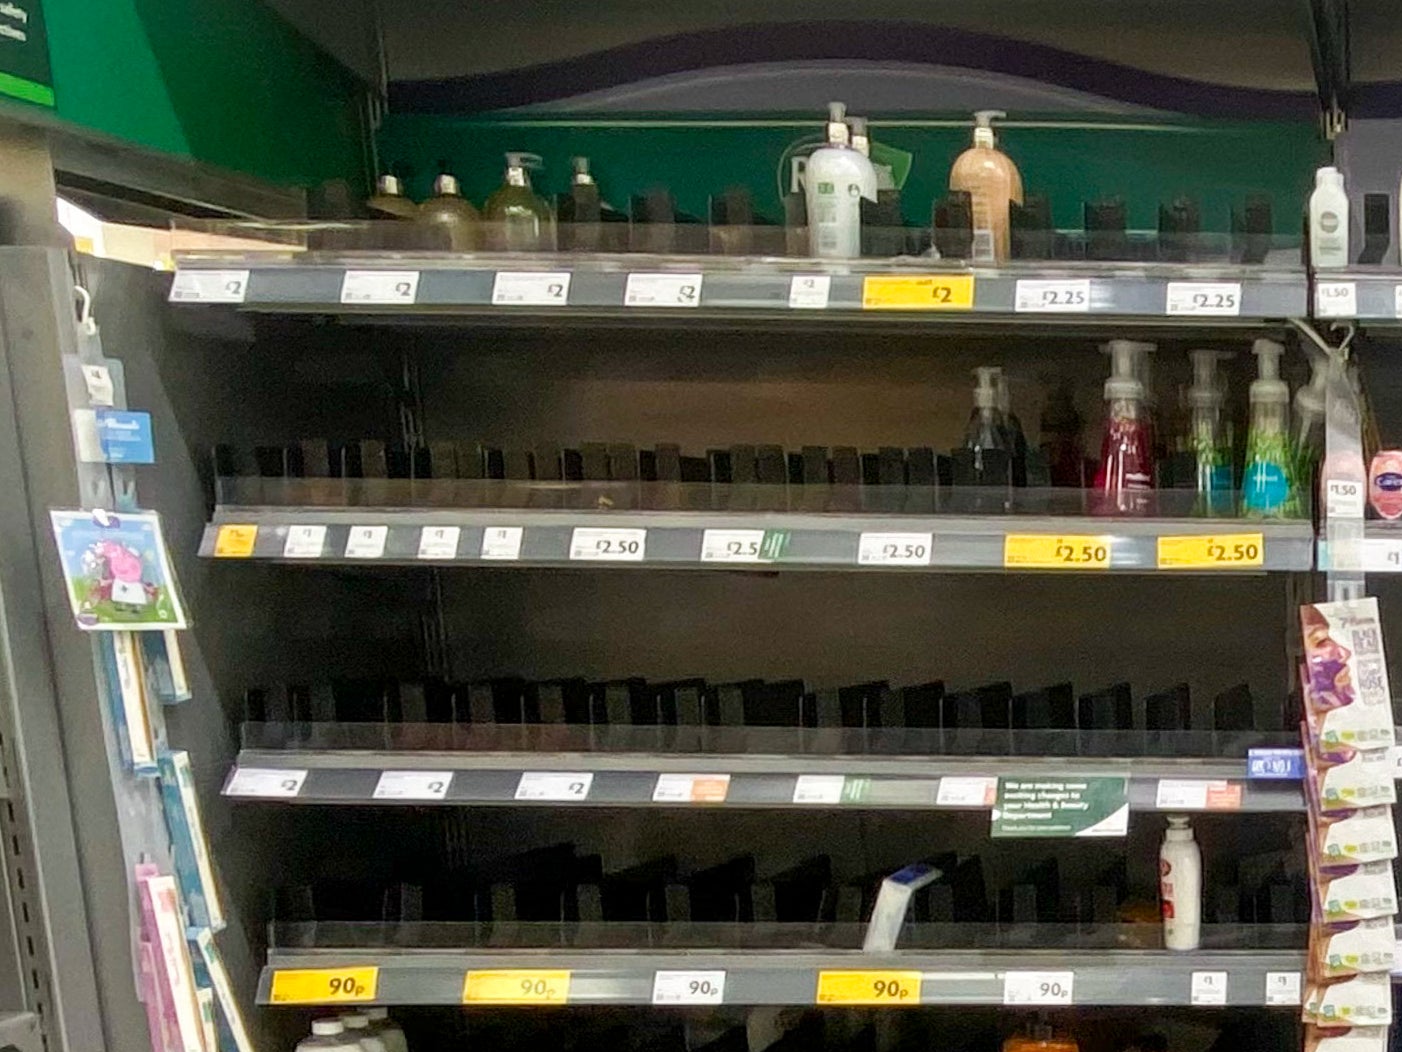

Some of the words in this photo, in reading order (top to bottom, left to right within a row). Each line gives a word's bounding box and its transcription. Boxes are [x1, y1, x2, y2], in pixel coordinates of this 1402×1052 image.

[226, 281, 242, 295] £2
[396, 282, 412, 296] £2
[548, 284, 563, 297] £2
[680, 286, 696, 300] £2
[933, 287, 951, 303] £2
[1043, 291, 1084, 304] £2.25
[1194, 294, 1235, 307] £2.25
[596, 540, 638, 554] £2.50
[727, 541, 758, 556] £2.5
[883, 543, 925, 558] £2.50
[1056, 545, 1106, 562] £2.50
[1207, 544, 1257, 561] £2.50
[281, 780, 297, 793] £2
[428, 781, 443, 794] £2
[568, 782, 584, 795] £2
[330, 976, 365, 995] 90p
[521, 979, 555, 998] 90p
[689, 980, 718, 996] 90p
[874, 980, 908, 997] 90p
[1040, 982, 1068, 997] 90p
